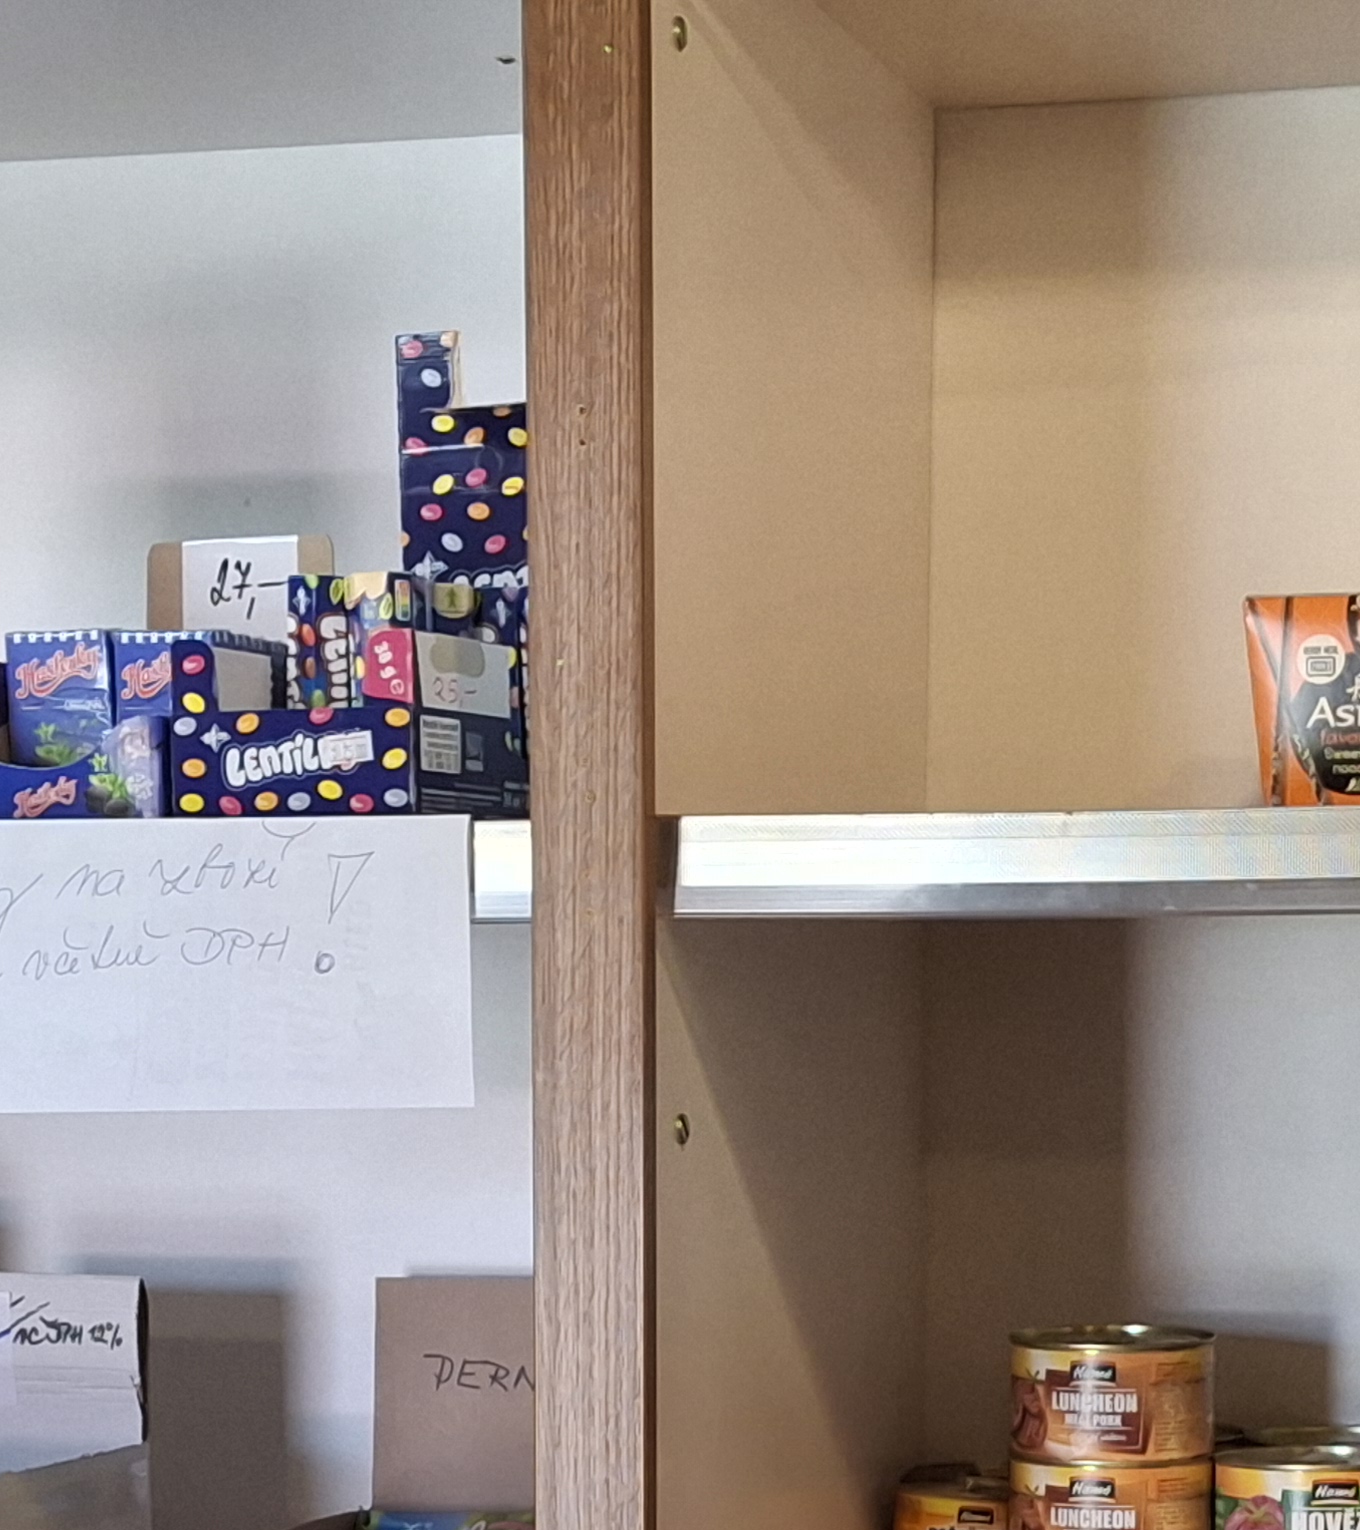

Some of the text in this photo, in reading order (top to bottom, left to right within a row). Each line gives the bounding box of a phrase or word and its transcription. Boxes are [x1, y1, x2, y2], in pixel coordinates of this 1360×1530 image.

[55, 865, 126, 899] na
[181, 927, 290, 969] DPH
[1051, 1391, 1138, 1414] LUNCHEON
[1050, 1507, 1136, 1530] LUNCHEON
